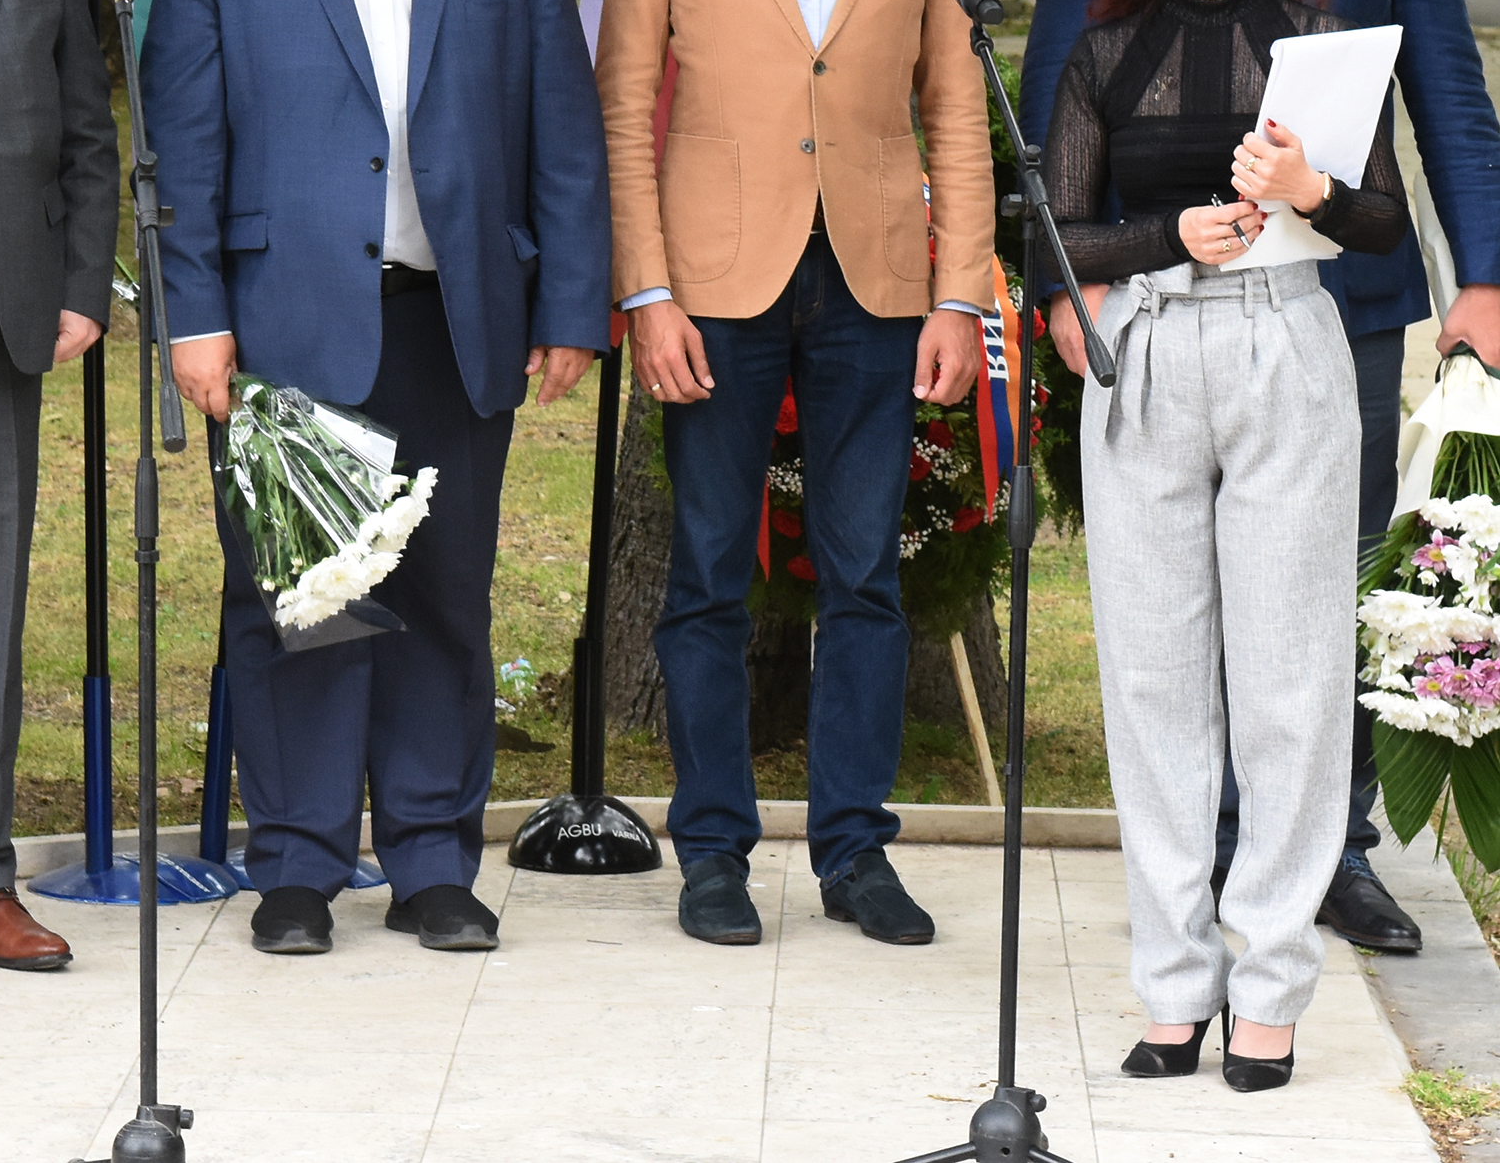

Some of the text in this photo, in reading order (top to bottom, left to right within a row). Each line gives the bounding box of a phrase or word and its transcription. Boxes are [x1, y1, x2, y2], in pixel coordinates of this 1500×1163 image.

[981, 295, 1011, 383] ИЯ
[557, 823, 641, 842] AGBU VARNA
